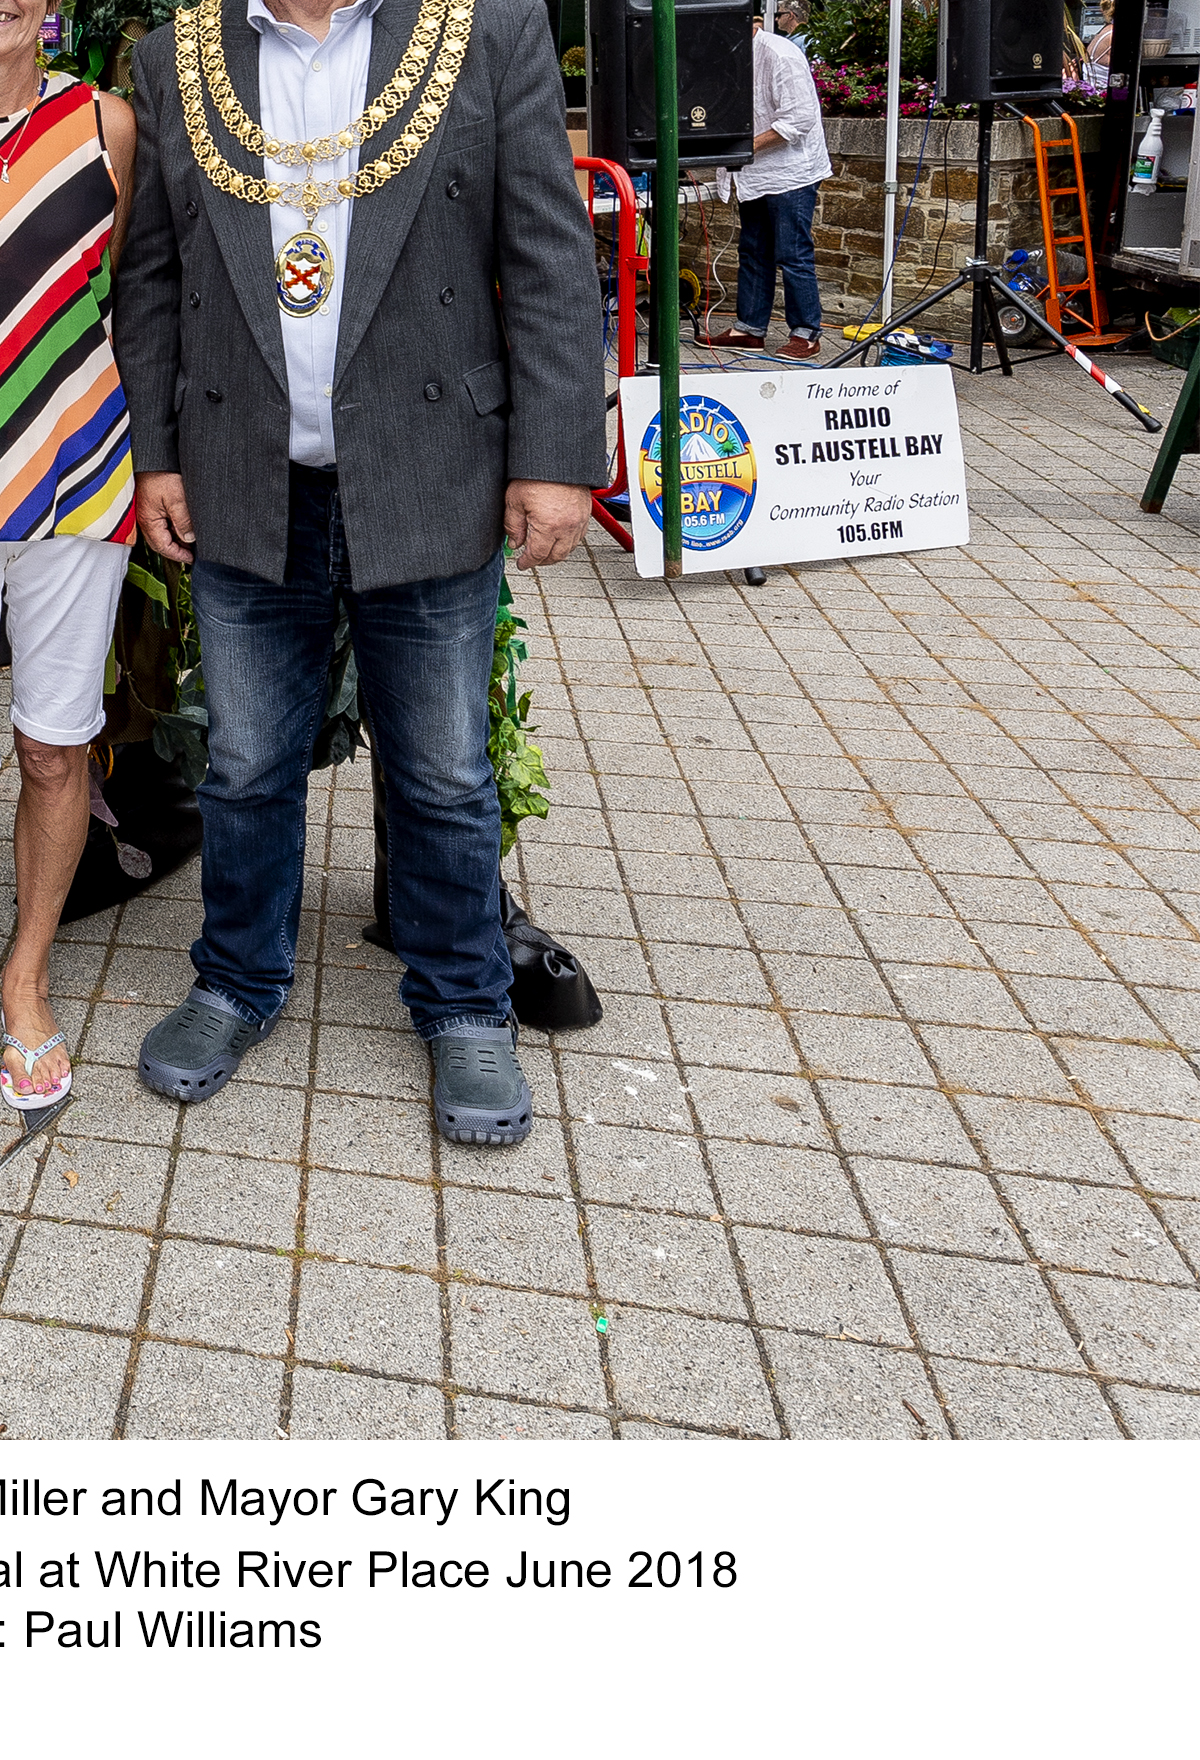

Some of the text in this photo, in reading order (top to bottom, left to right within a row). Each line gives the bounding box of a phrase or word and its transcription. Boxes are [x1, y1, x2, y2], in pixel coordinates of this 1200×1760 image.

[806, 379, 902, 399] The home of
[679, 412, 730, 444] ADIO
[824, 406, 892, 431] RADIO
[774, 433, 943, 466] ST. AUSTELL BAY
[849, 469, 882, 487] Your
[681, 490, 723, 514] BAY
[769, 490, 960, 521] Community Radio Station
[709, 512, 726, 525] FM
[836, 520, 904, 544] 105.6FM
